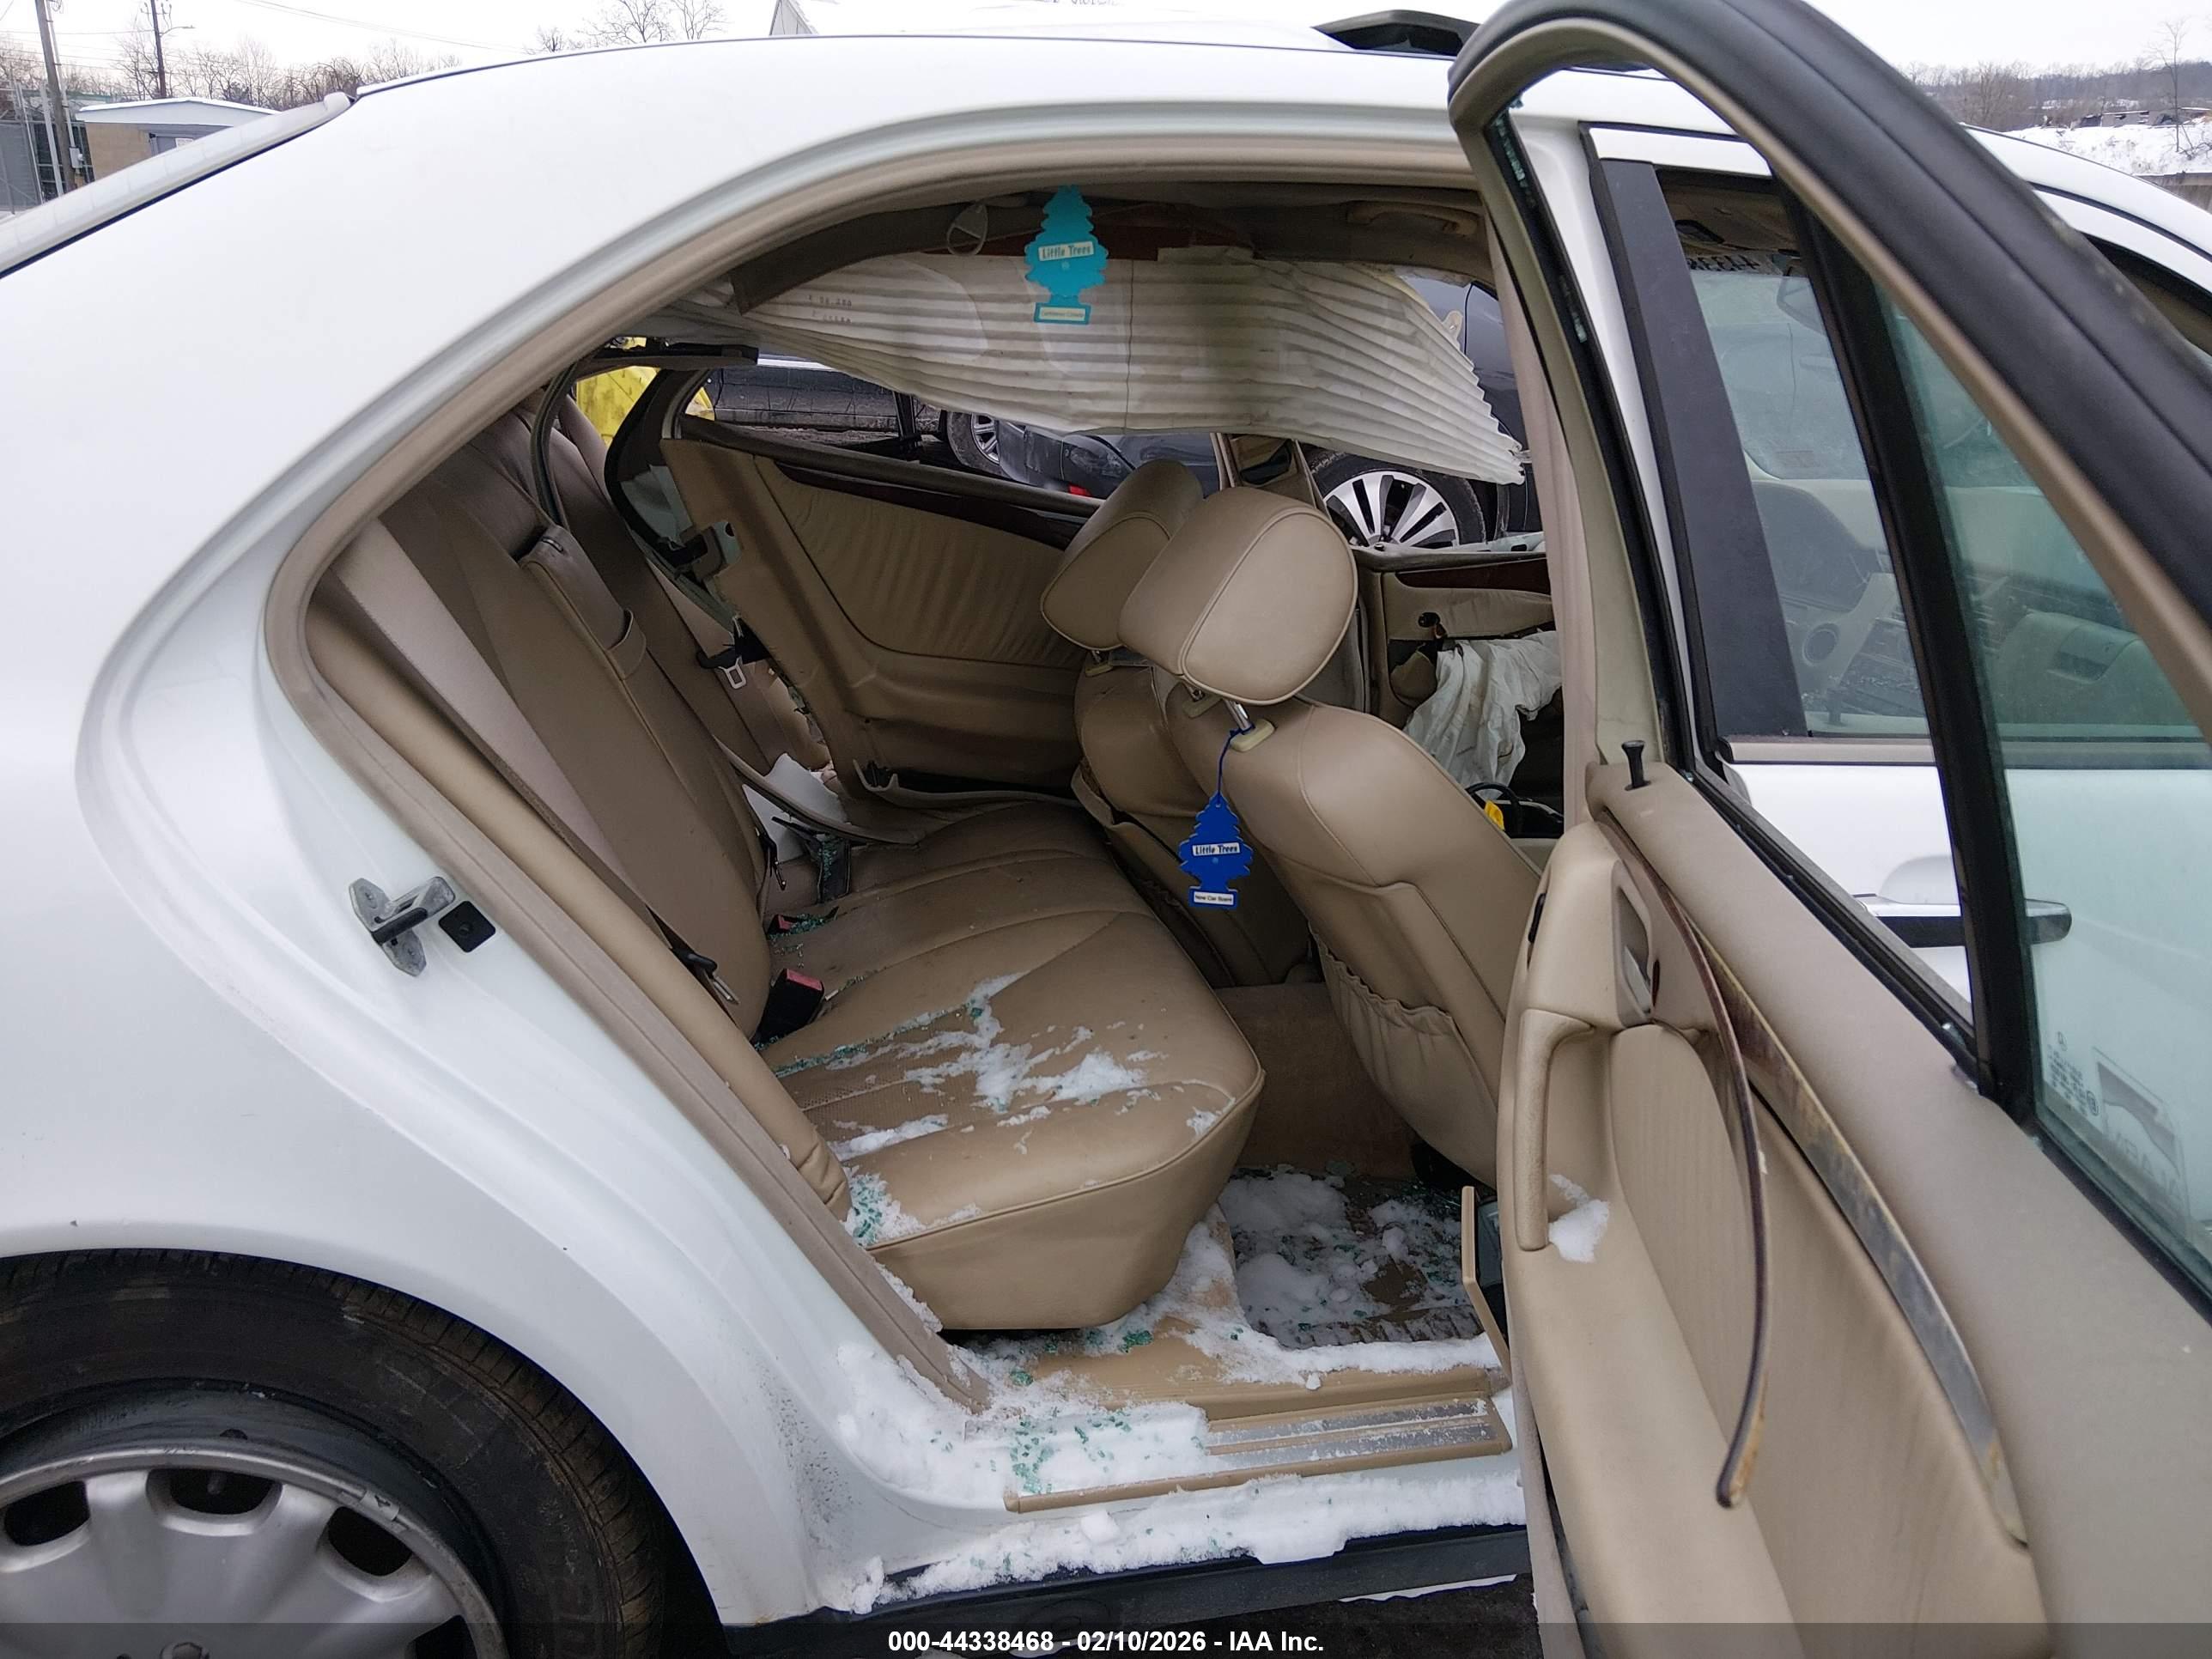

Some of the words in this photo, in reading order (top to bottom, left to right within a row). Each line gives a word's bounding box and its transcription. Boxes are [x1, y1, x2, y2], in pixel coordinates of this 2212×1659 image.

[1042, 247, 1065, 259] Little
[1067, 245, 1091, 258] Trees
[1195, 845, 1215, 855] Little
[1218, 844, 1237, 853] Trees
